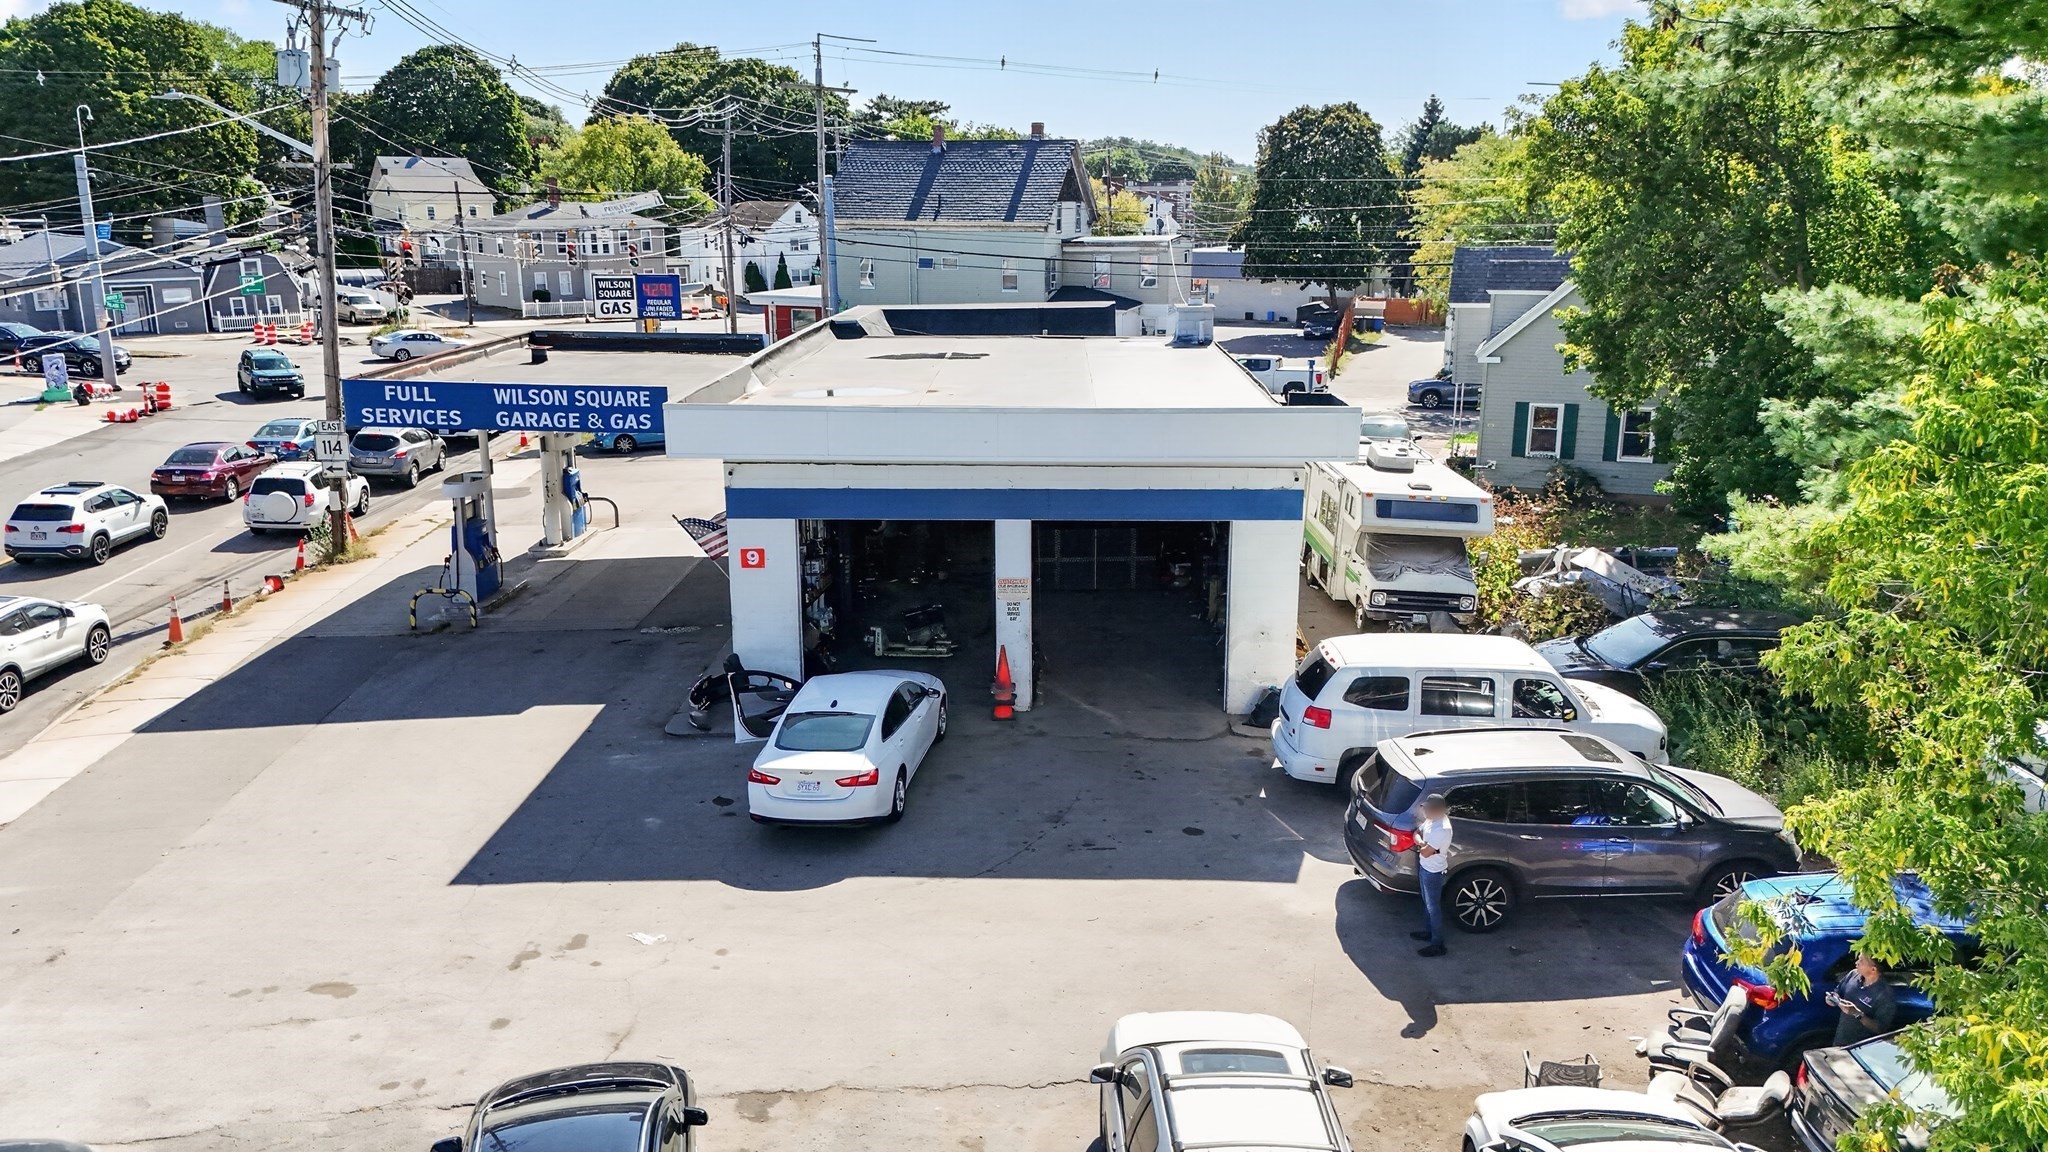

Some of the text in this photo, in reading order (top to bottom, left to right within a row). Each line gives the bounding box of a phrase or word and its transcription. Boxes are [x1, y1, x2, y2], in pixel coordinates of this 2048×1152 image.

[598, 290, 632, 298] SQUARE
[600, 302, 632, 314] GAS
[384, 385, 437, 402] FULL
[493, 388, 651, 409] WILSON SQUARE
[361, 408, 462, 426] SERVICES
[495, 411, 652, 430] GARAGE & GAS
[321, 421, 341, 431] EAST
[322, 440, 343, 455] 114
[746, 550, 760, 566] 9
